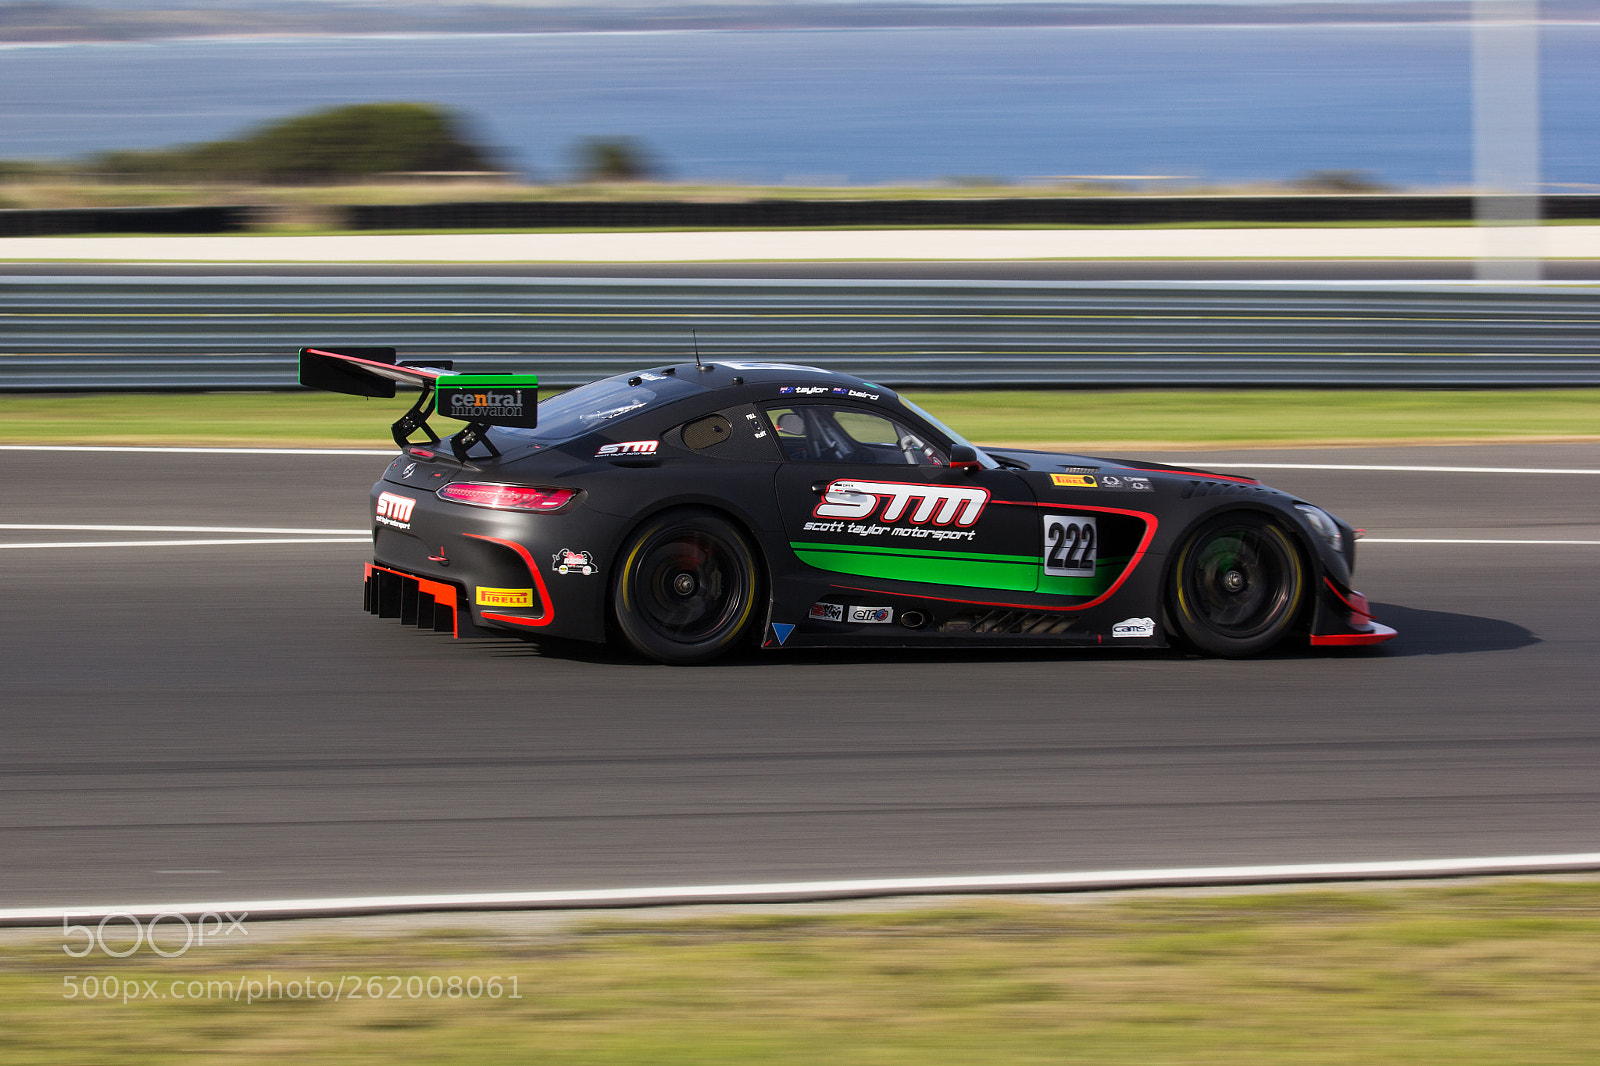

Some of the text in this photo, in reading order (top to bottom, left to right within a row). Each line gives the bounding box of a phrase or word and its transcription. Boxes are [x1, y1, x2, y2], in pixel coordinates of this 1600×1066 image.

[795, 386, 829, 395] taylor
[848, 389, 880, 400] baird
[450, 390, 523, 407] central
[450, 405, 523, 417] innovation
[597, 440, 660, 455] STM
[376, 491, 417, 523] STM
[813, 479, 991, 528] STM
[803, 521, 976, 542] scott taylor motorsport
[1046, 521, 1096, 571] 222
[481, 590, 528, 603] PIRELLI
[853, 609, 877, 621] elf
